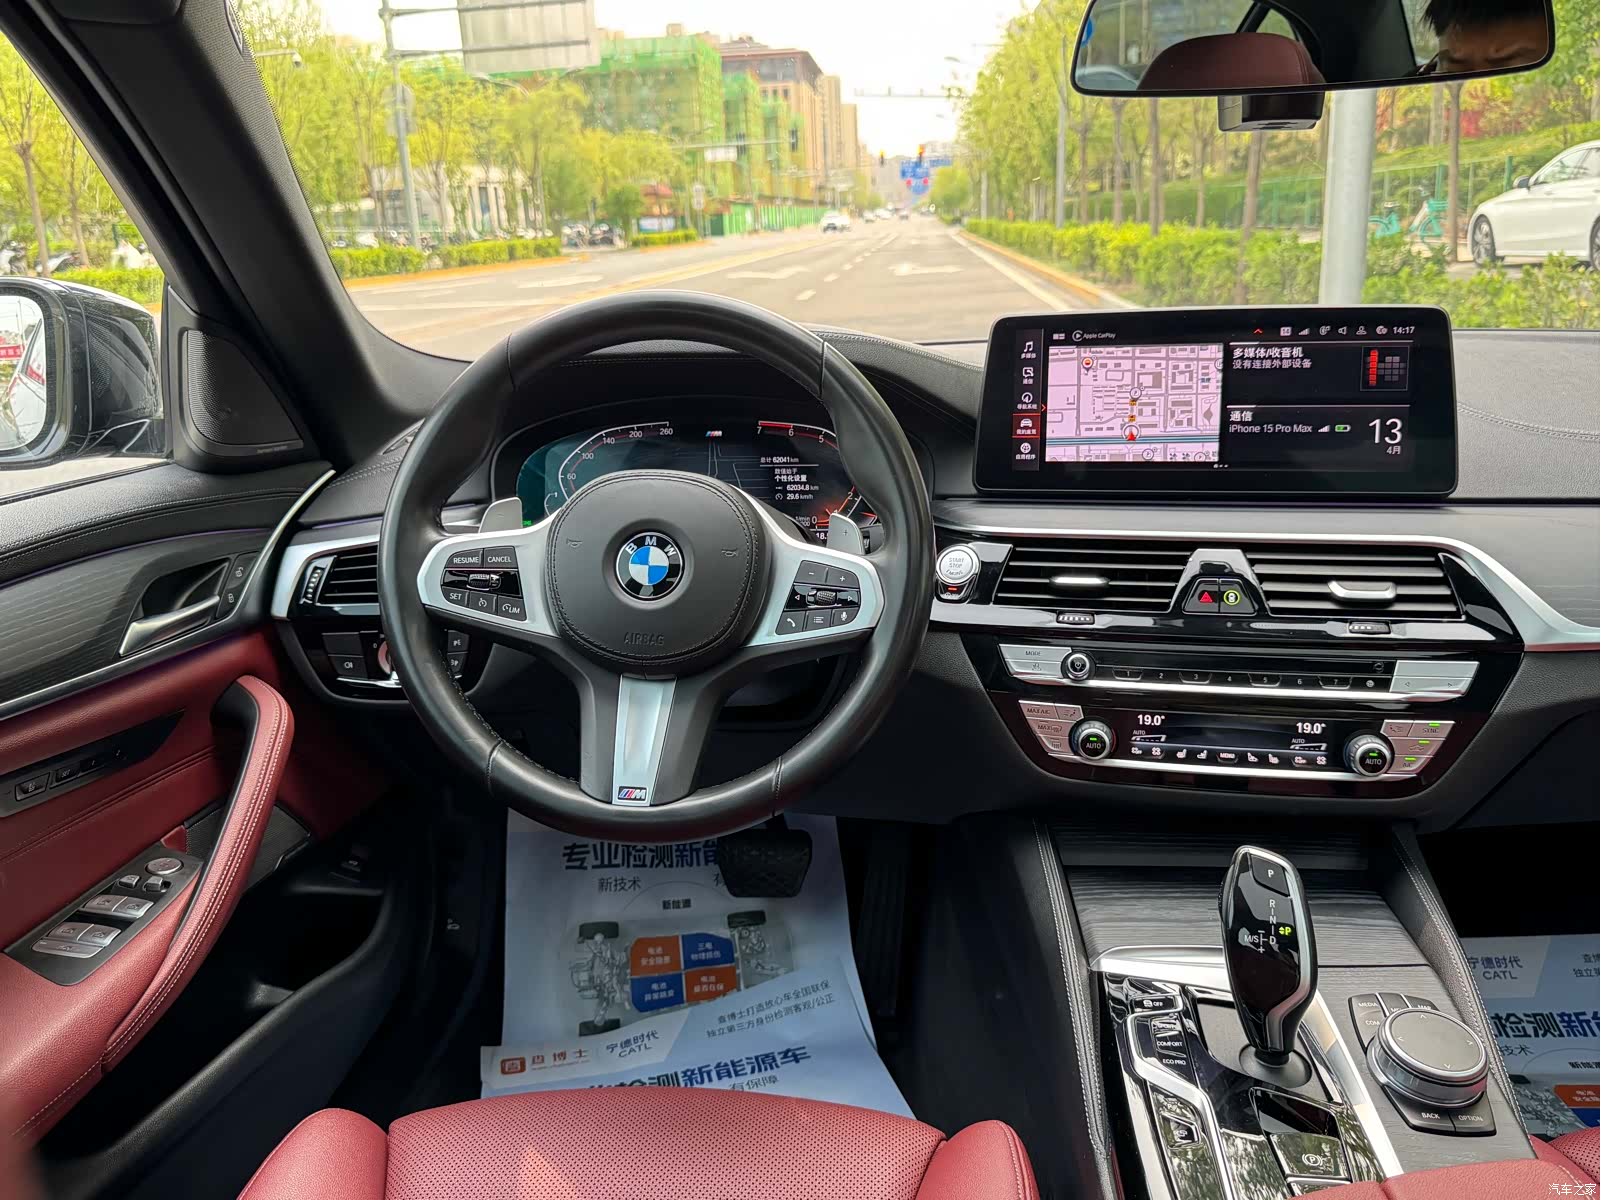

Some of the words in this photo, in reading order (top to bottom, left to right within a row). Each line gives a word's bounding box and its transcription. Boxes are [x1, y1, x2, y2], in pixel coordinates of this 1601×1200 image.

[1393, 326, 1415, 334] 14:17
[1233, 347, 1304, 358] 多媒体/收音机
[1233, 359, 1312, 369] 没有连接外部设备
[1230, 411, 1253, 421] 通信
[660, 428, 673, 436] 260
[756, 426, 762, 435] 7
[788, 428, 794, 437] 6
[1229, 424, 1261, 433] iPhone
[1263, 424, 1274, 432] 15
[1276, 424, 1291, 432] Pro
[1293, 424, 1313, 432] Max
[1369, 418, 1402, 444] 13
[629, 430, 642, 438] 200
[603, 437, 615, 445] 140
[818, 435, 824, 444] 5
[1386, 446, 1401, 455] 4月
[582, 452, 594, 460] 100
[847, 492, 853, 500] 2
[625, 535, 677, 557] BMW
[624, 632, 664, 645] AIRBAG
[1268, 869, 1274, 877] P
[598, 876, 642, 893] 新技术
[1269, 899, 1275, 907] R
[1270, 916, 1276, 924] N
[1285, 927, 1291, 935] P
[1245, 935, 1259, 943] M/S
[1270, 936, 1276, 944] D
[1468, 956, 1523, 969] 宁德时代
[1483, 971, 1518, 980] CATL
[606, 1030, 659, 1053] 宁德时代
[619, 1043, 652, 1058] CATL
